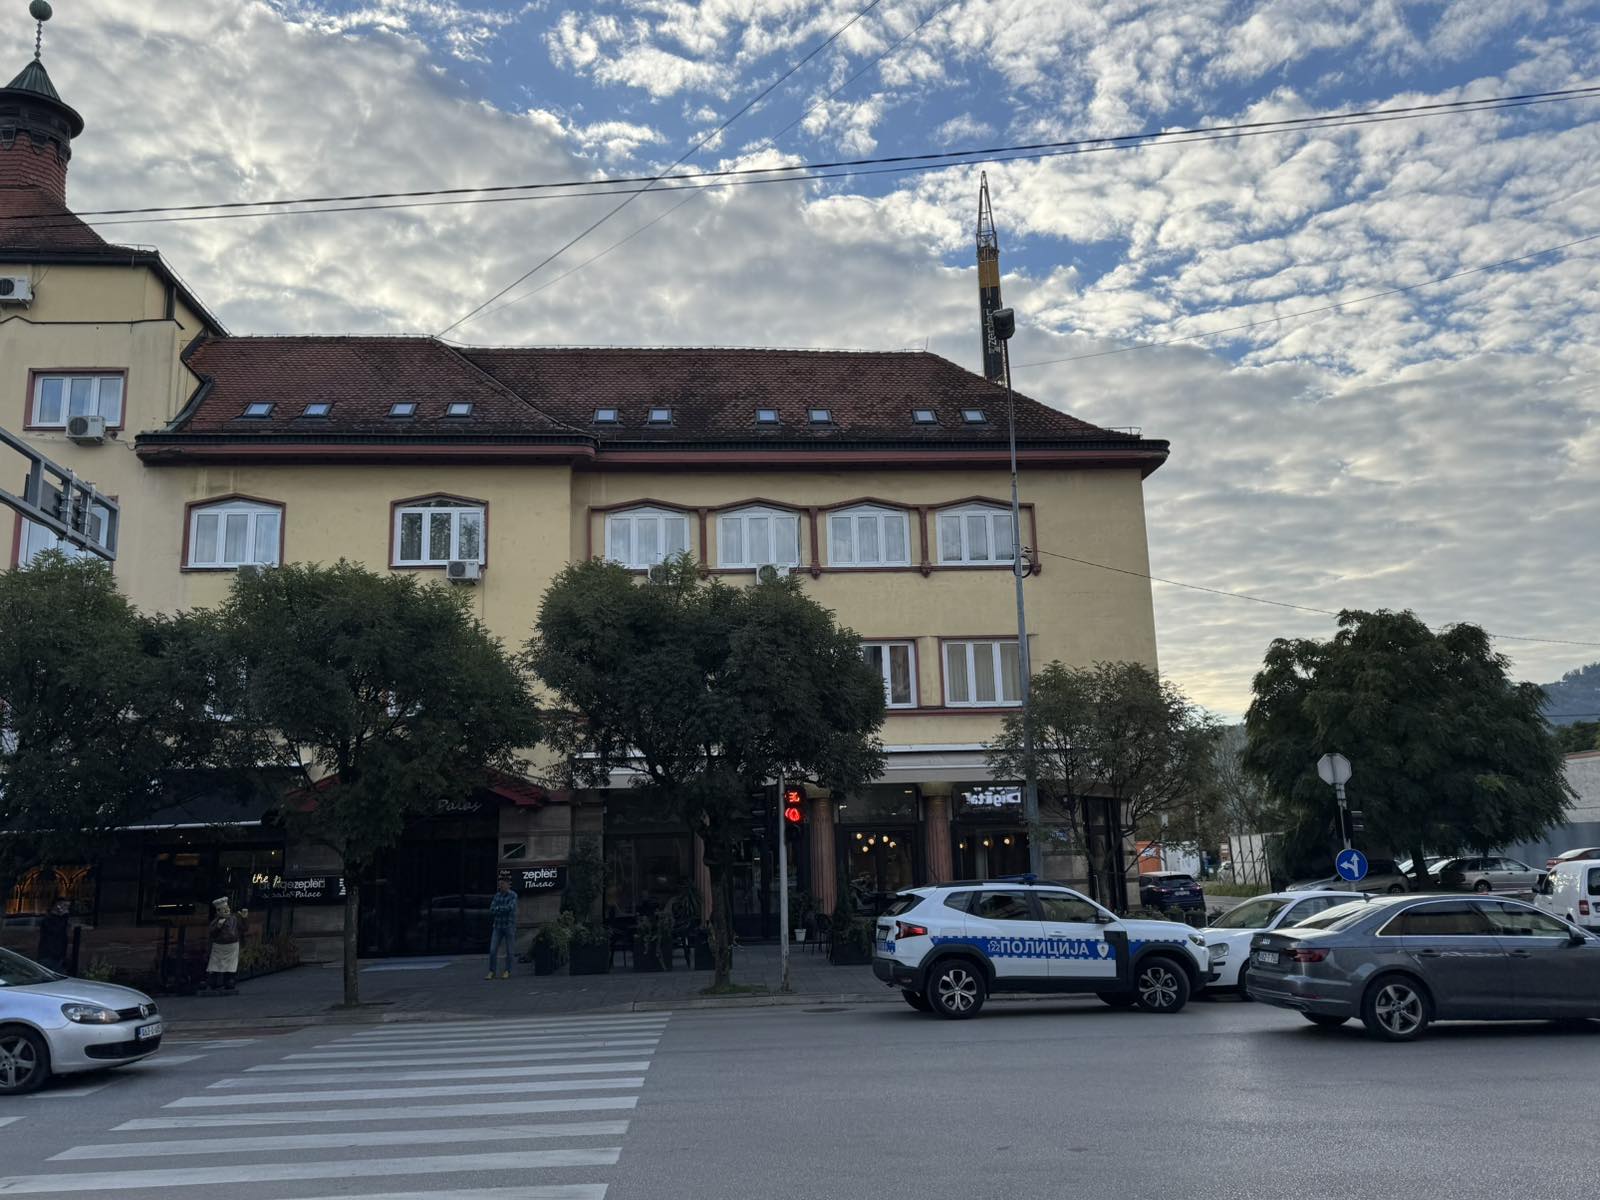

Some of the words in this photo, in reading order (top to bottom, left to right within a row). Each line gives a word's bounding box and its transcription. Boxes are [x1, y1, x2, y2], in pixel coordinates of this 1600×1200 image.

[522, 868, 554, 882] zepter
[294, 877, 322, 891] zepter
[1000, 940, 1090, 957] ПОЛИЦИЈА
